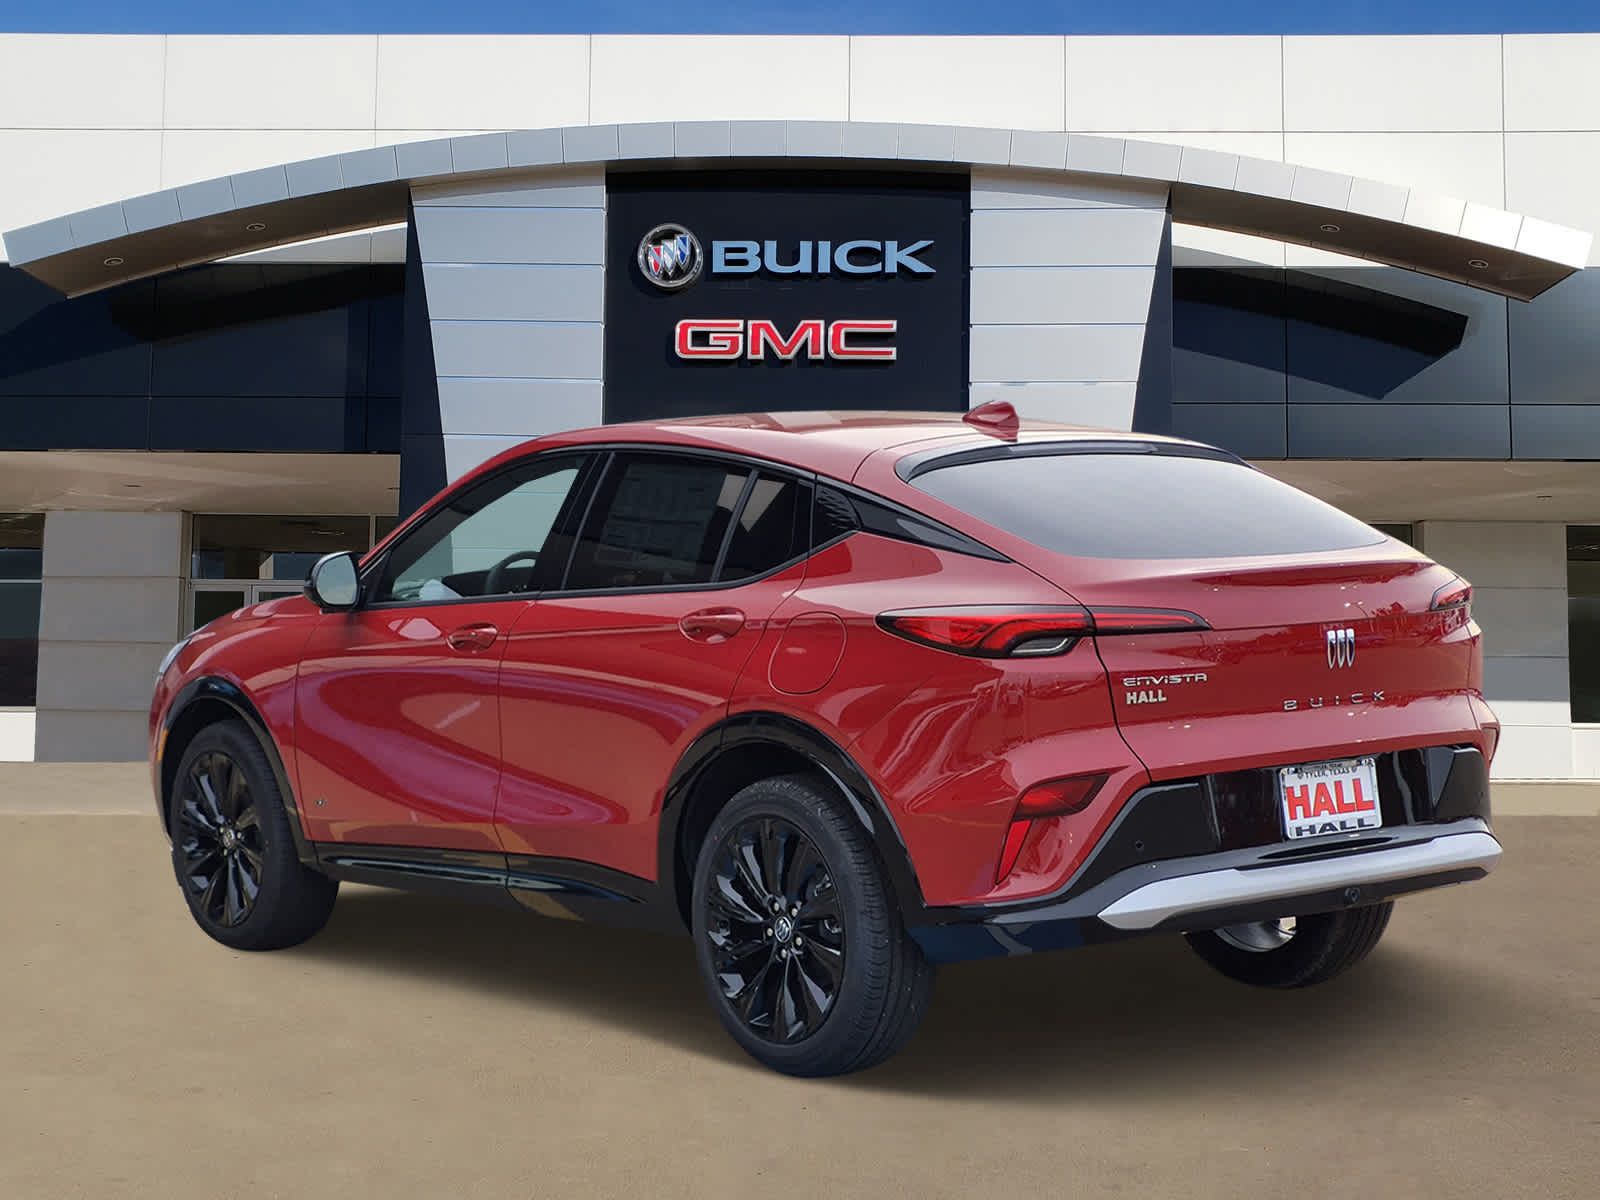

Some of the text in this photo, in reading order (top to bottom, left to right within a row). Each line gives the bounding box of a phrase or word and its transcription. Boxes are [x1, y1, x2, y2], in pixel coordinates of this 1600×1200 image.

[712, 240, 937, 273] BUICK
[675, 319, 897, 360] GMC
[1126, 689, 1167, 705] HALL
[1283, 690, 1385, 710] BUICK
[1285, 778, 1375, 820] HALL
[1295, 818, 1375, 837] HALL
